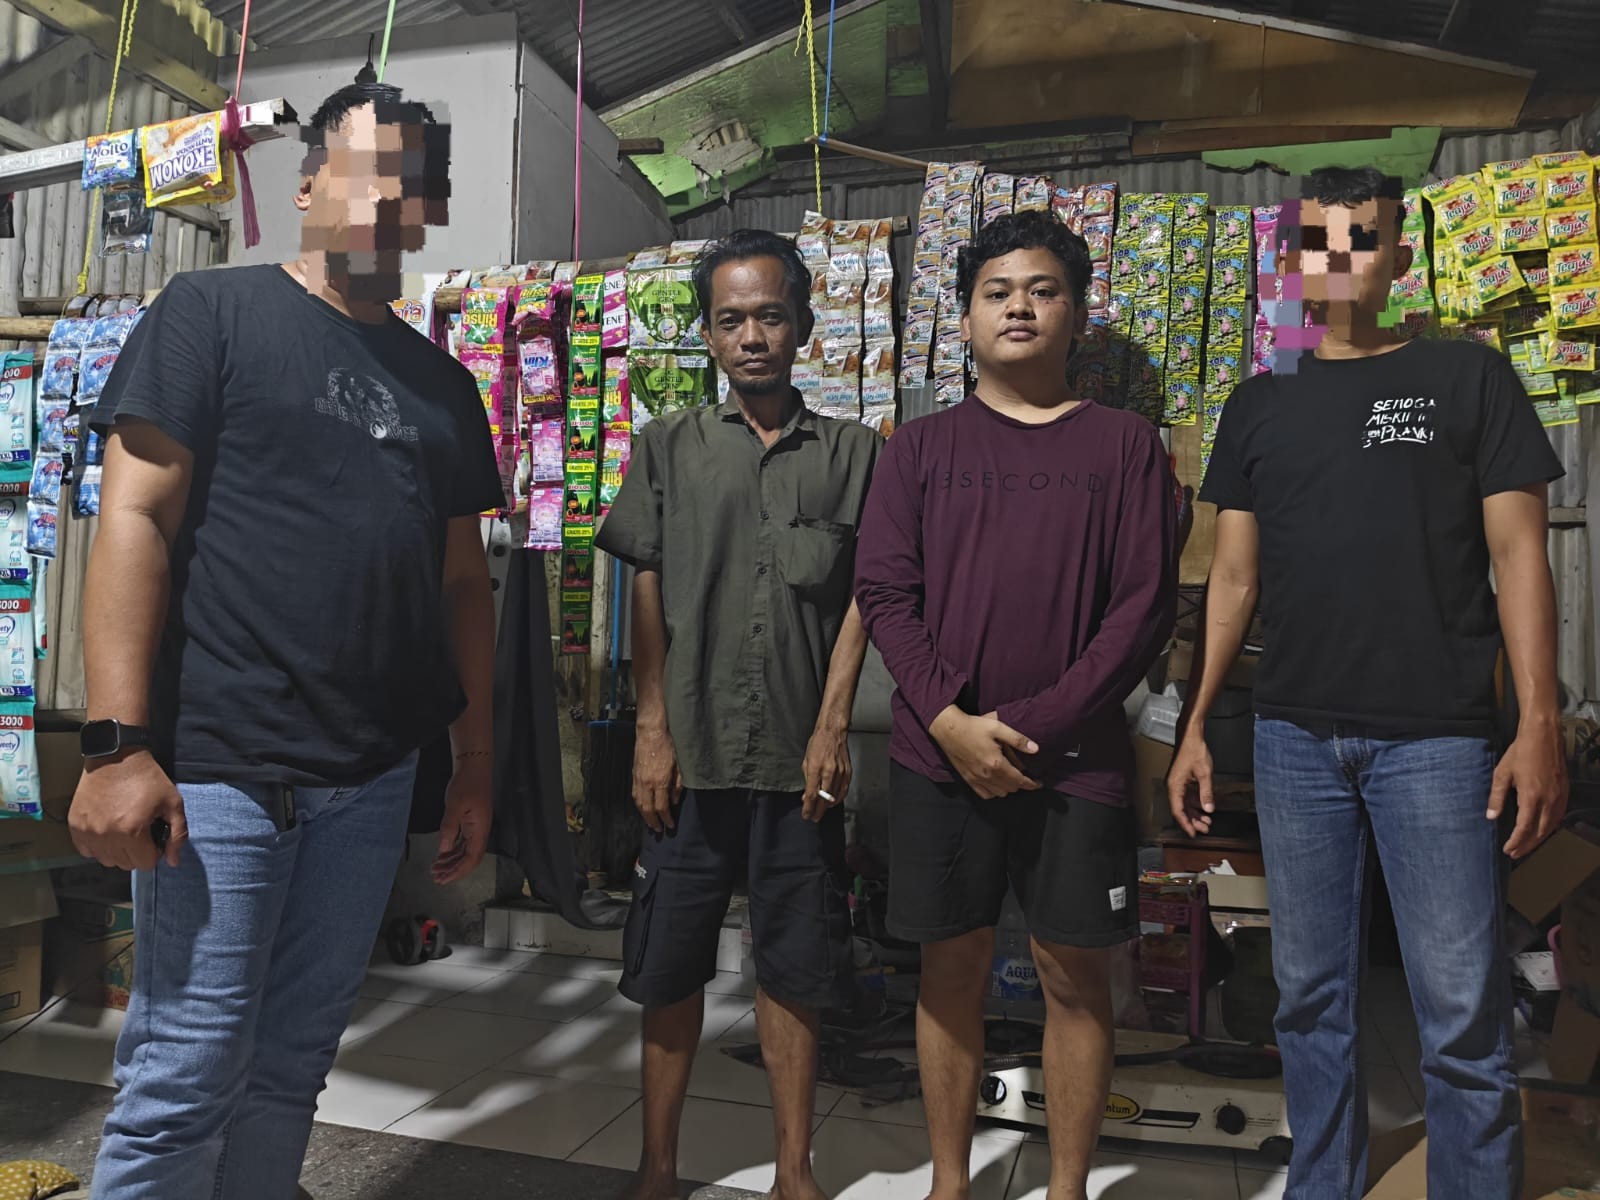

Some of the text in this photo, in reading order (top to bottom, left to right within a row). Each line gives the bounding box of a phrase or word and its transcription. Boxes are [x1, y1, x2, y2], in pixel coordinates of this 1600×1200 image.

[1525, 269, 1548, 283] eaju
[463, 313, 497, 328] Rinso
[4, 368, 20, 379] 000
[604, 390, 621, 405] Rin
[603, 472, 622, 486] Rin
[1005, 966, 1038, 979] AQUA
[1105, 1104, 1130, 1114] ntum
